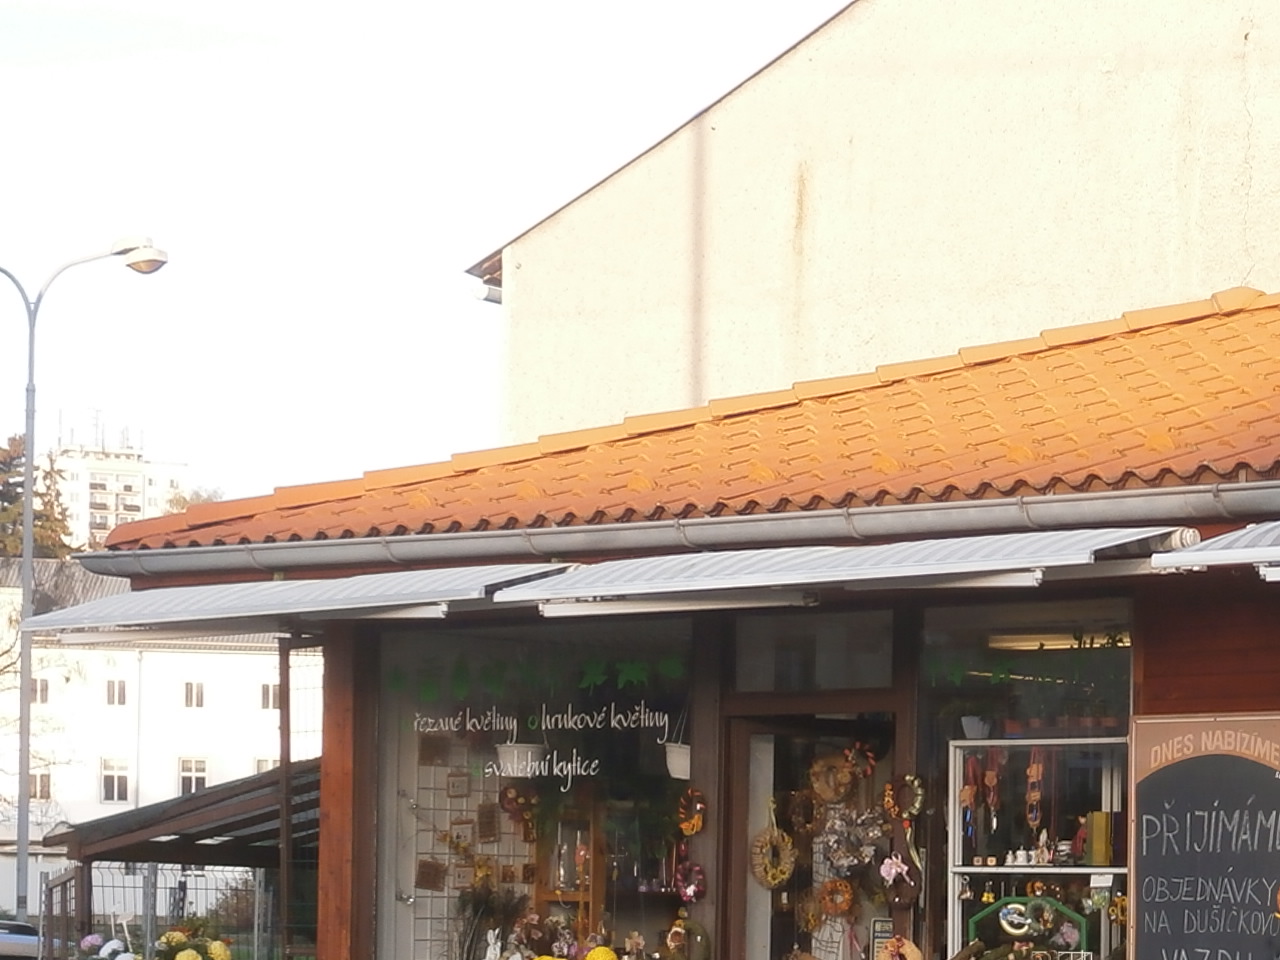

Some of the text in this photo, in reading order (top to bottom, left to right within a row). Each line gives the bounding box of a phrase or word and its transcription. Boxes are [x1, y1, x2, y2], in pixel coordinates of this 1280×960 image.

[413, 709, 462, 732] řezané
[465, 705, 518, 745] květiny
[610, 700, 669, 744] květiny
[1151, 729, 1280, 768] DNES NABÍZÍME
[484, 748, 600, 792] svatební kytice
[1142, 867, 1277, 907] OBJEDNÁVKY
[1144, 910, 1171, 935] NA
